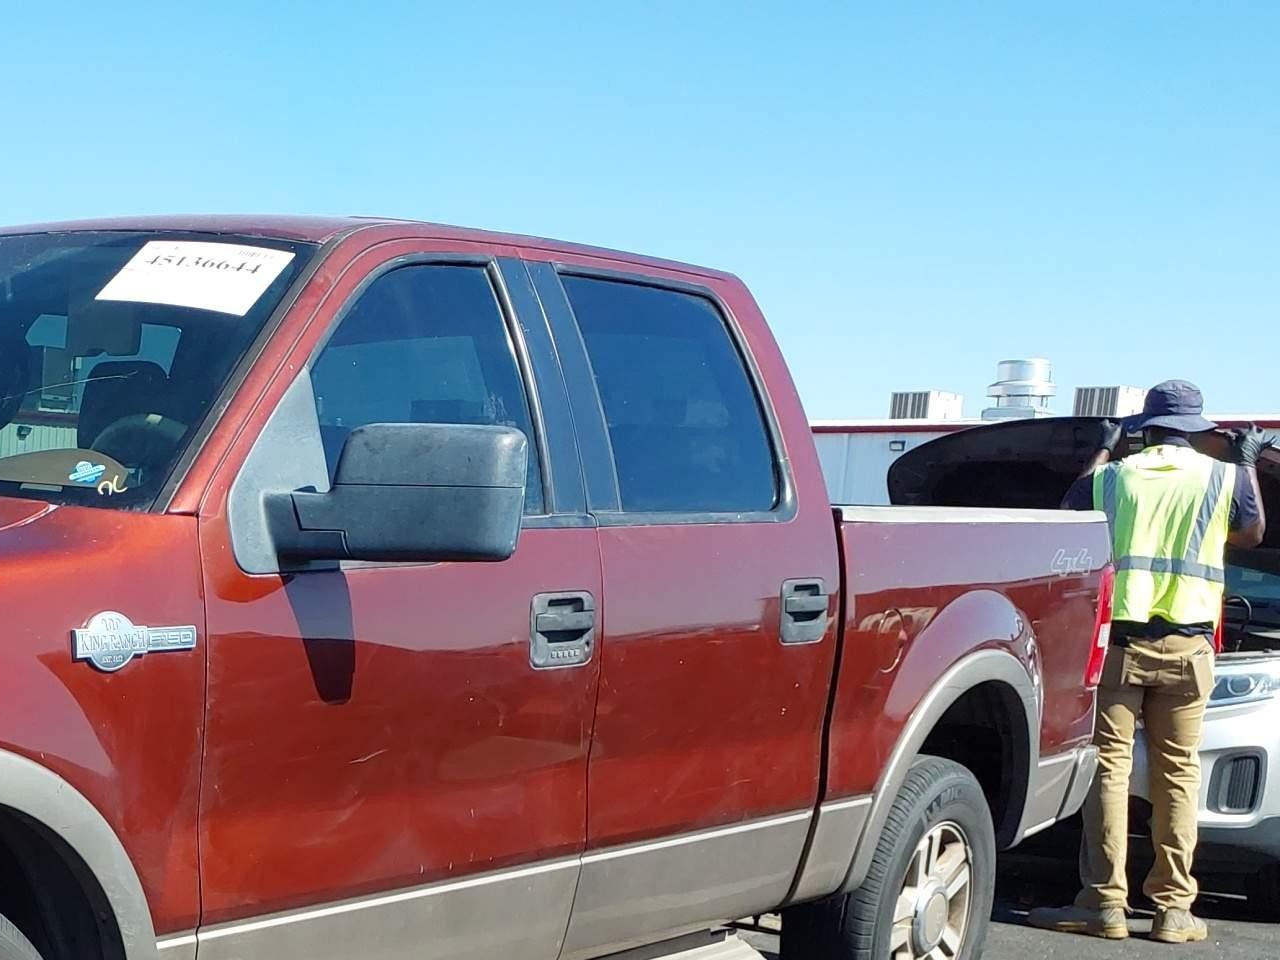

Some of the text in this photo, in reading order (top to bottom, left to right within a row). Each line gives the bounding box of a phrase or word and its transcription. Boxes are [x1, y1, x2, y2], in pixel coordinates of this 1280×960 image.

[144, 254, 263, 276] 45136644
[79, 631, 147, 653] KING RANCH
